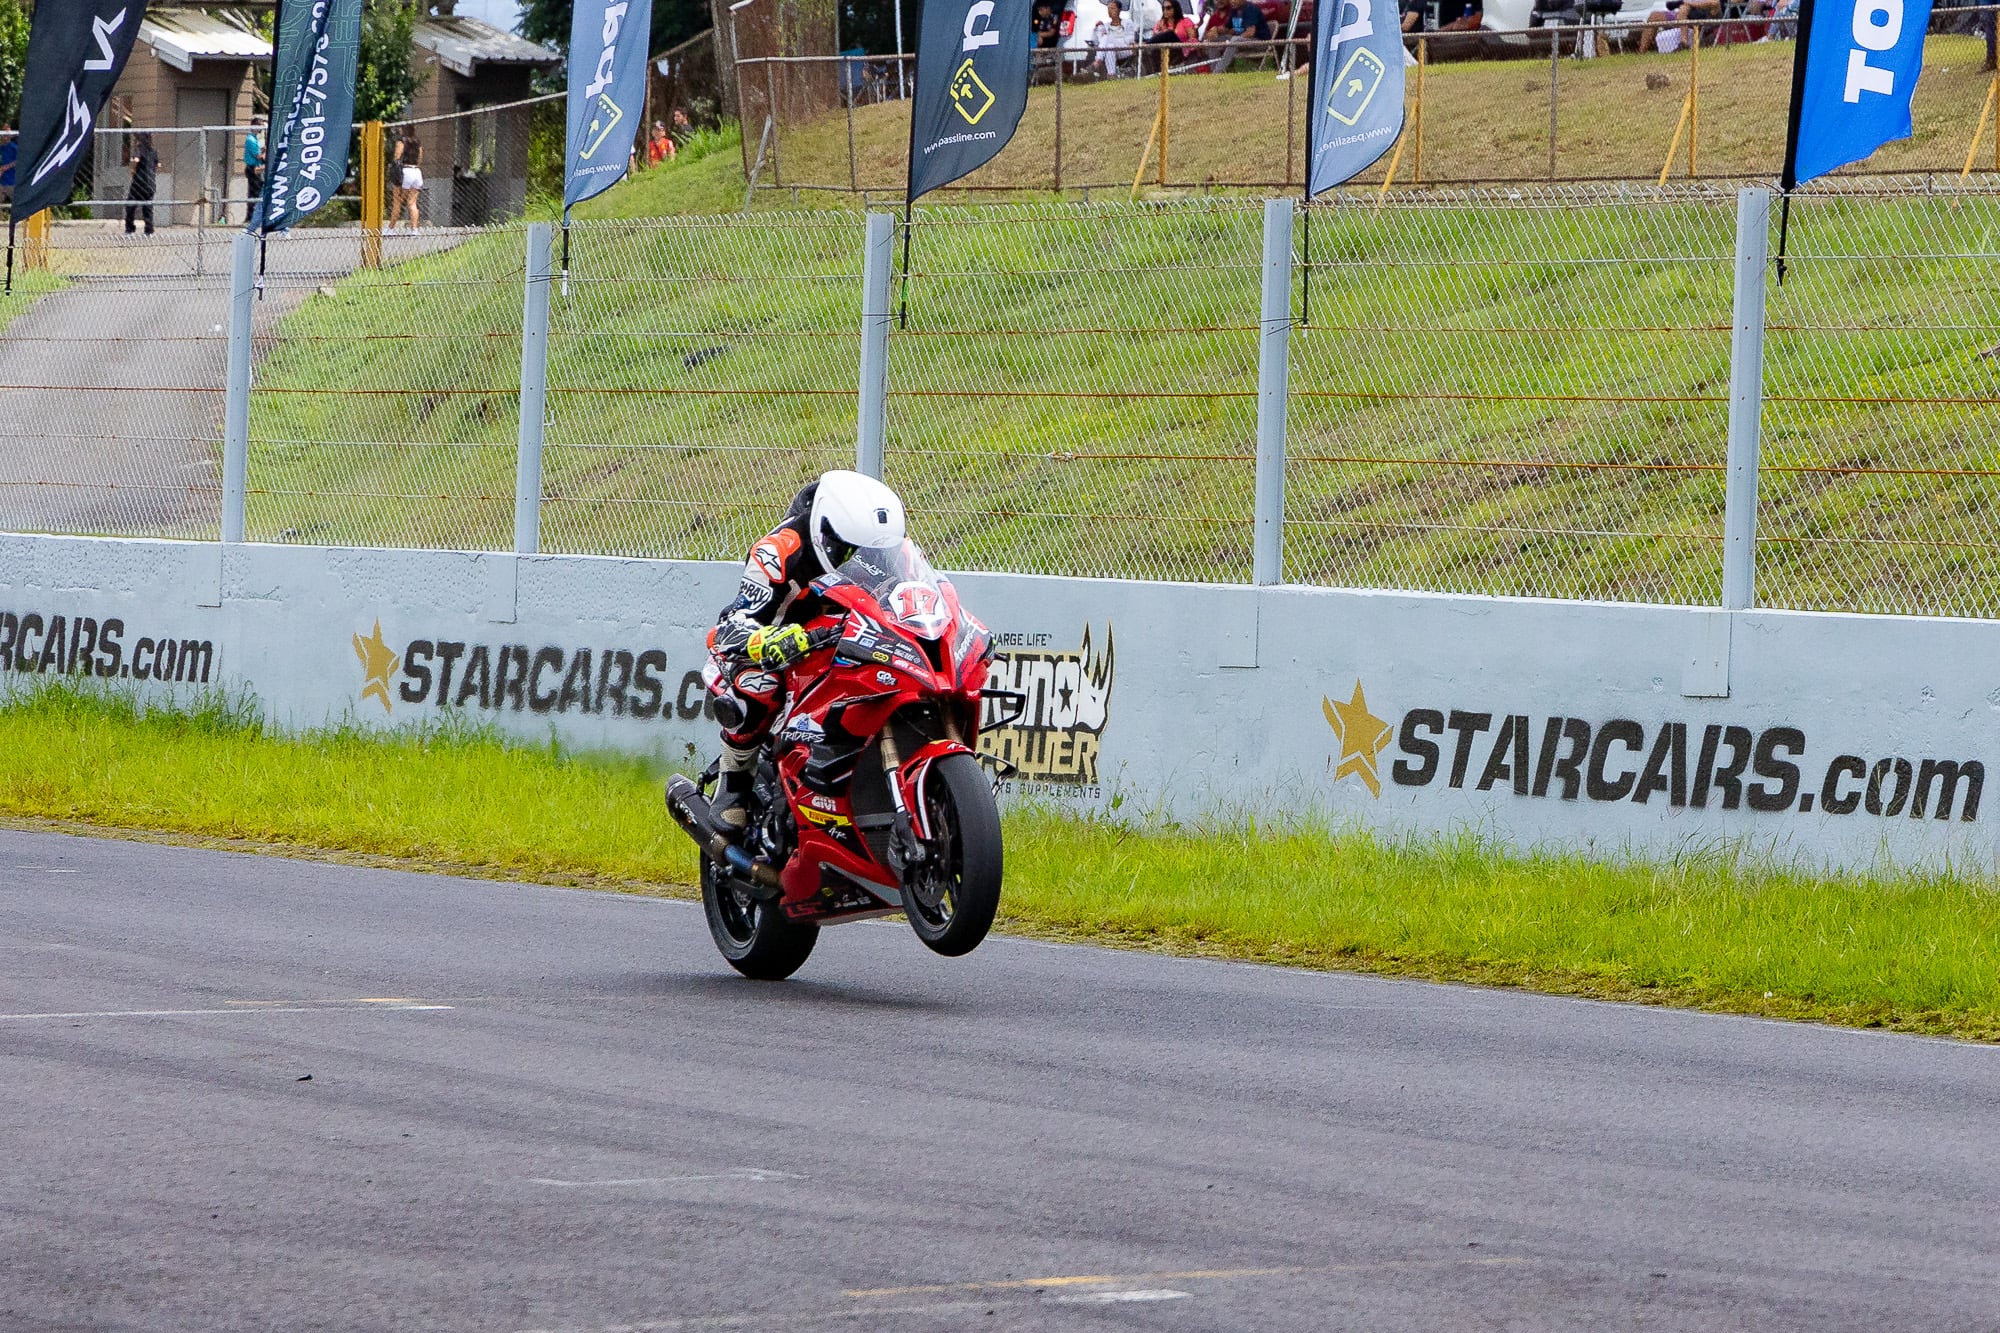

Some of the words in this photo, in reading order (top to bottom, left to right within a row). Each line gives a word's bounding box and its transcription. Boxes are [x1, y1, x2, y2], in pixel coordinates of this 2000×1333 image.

[898, 588, 938, 620] 17
[400, 639, 716, 721] STARCARS.c
[1392, 708, 1985, 822] STARCARS.com
[811, 795, 836, 811] GIVI
